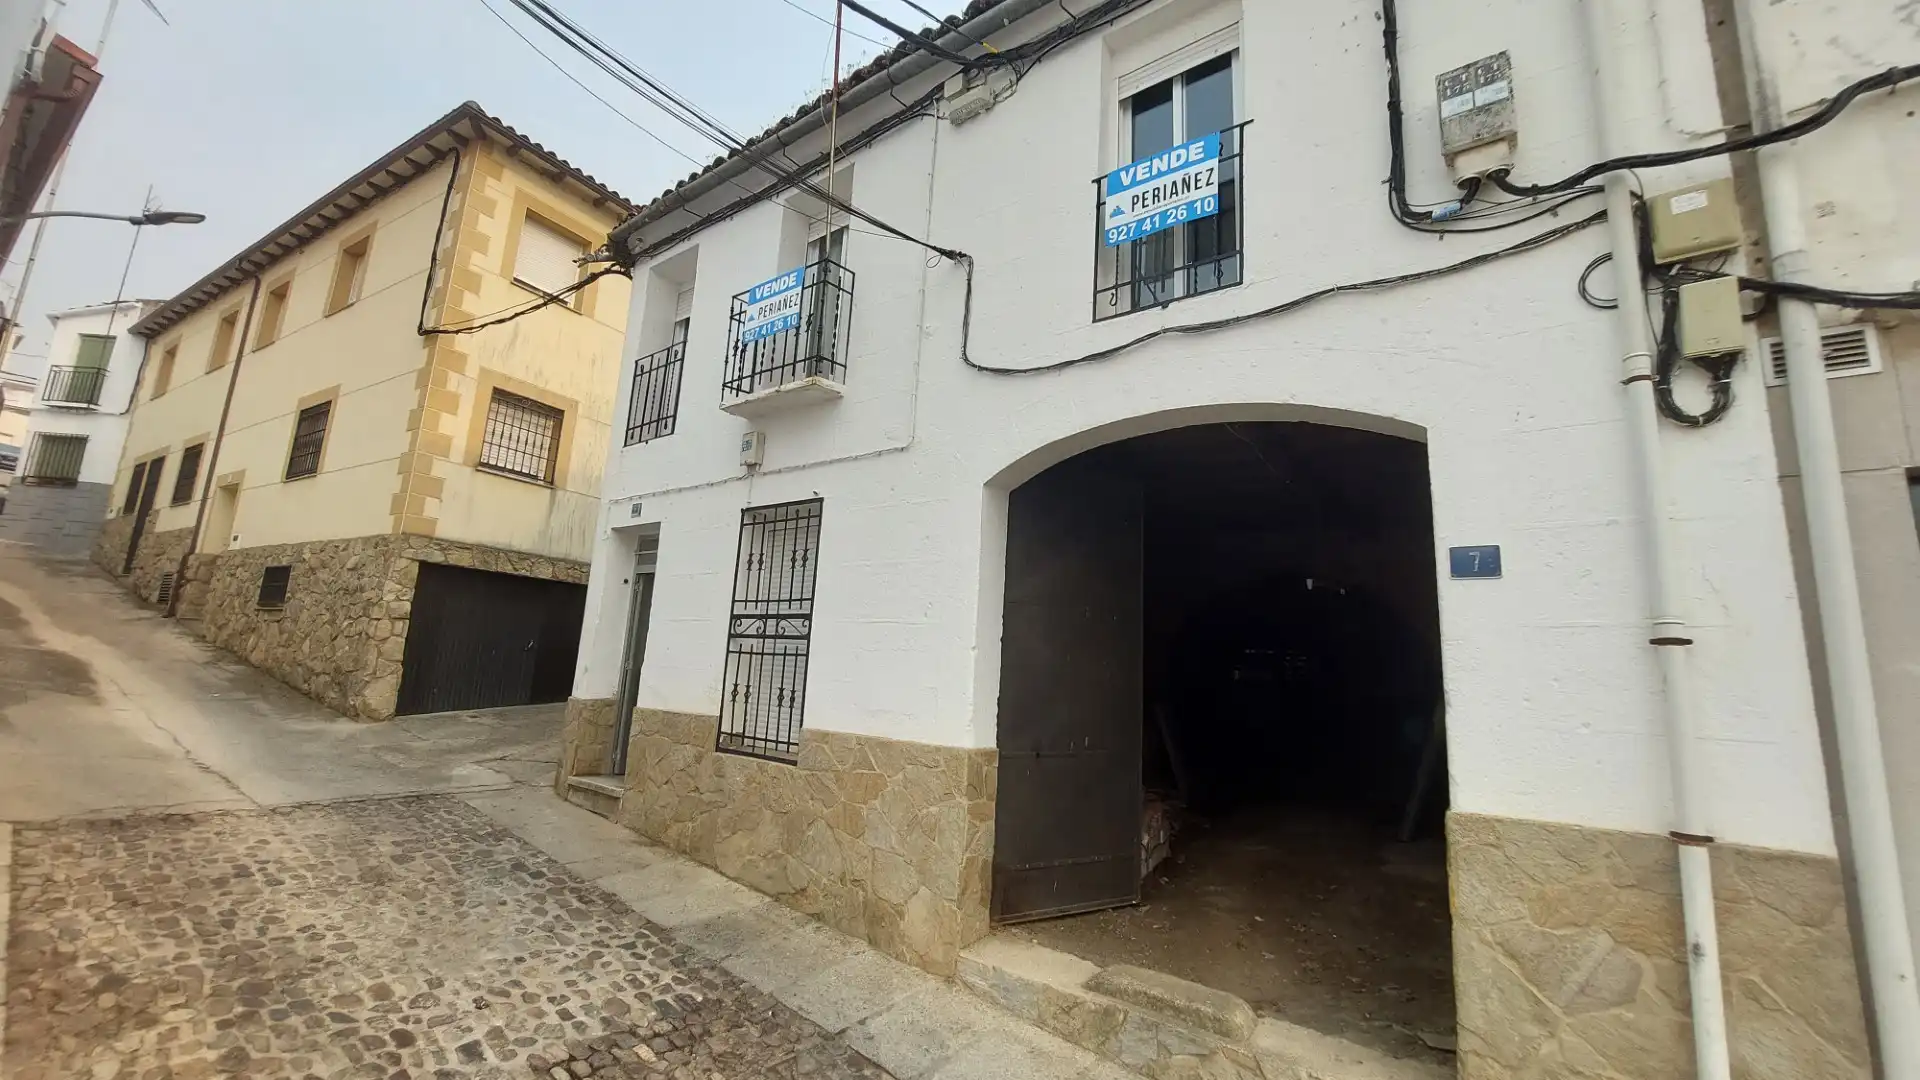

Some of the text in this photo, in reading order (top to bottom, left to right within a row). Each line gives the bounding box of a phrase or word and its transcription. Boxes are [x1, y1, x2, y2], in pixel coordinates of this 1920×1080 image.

[1120, 141, 1205, 186] VENDE
[1131, 167, 1214, 212] PERIAÑEZ
[1108, 223, 1136, 243] 927
[1141, 215, 1160, 232] 41
[1166, 205, 1187, 224] 26
[1193, 197, 1214, 215] 10
[755, 271, 798, 300] VENDE
[745, 328, 759, 341] 927
[761, 324, 771, 335] 41
[774, 319, 784, 331] 26
[787, 315, 798, 327] 10
[1469, 551, 1480, 572] 7
